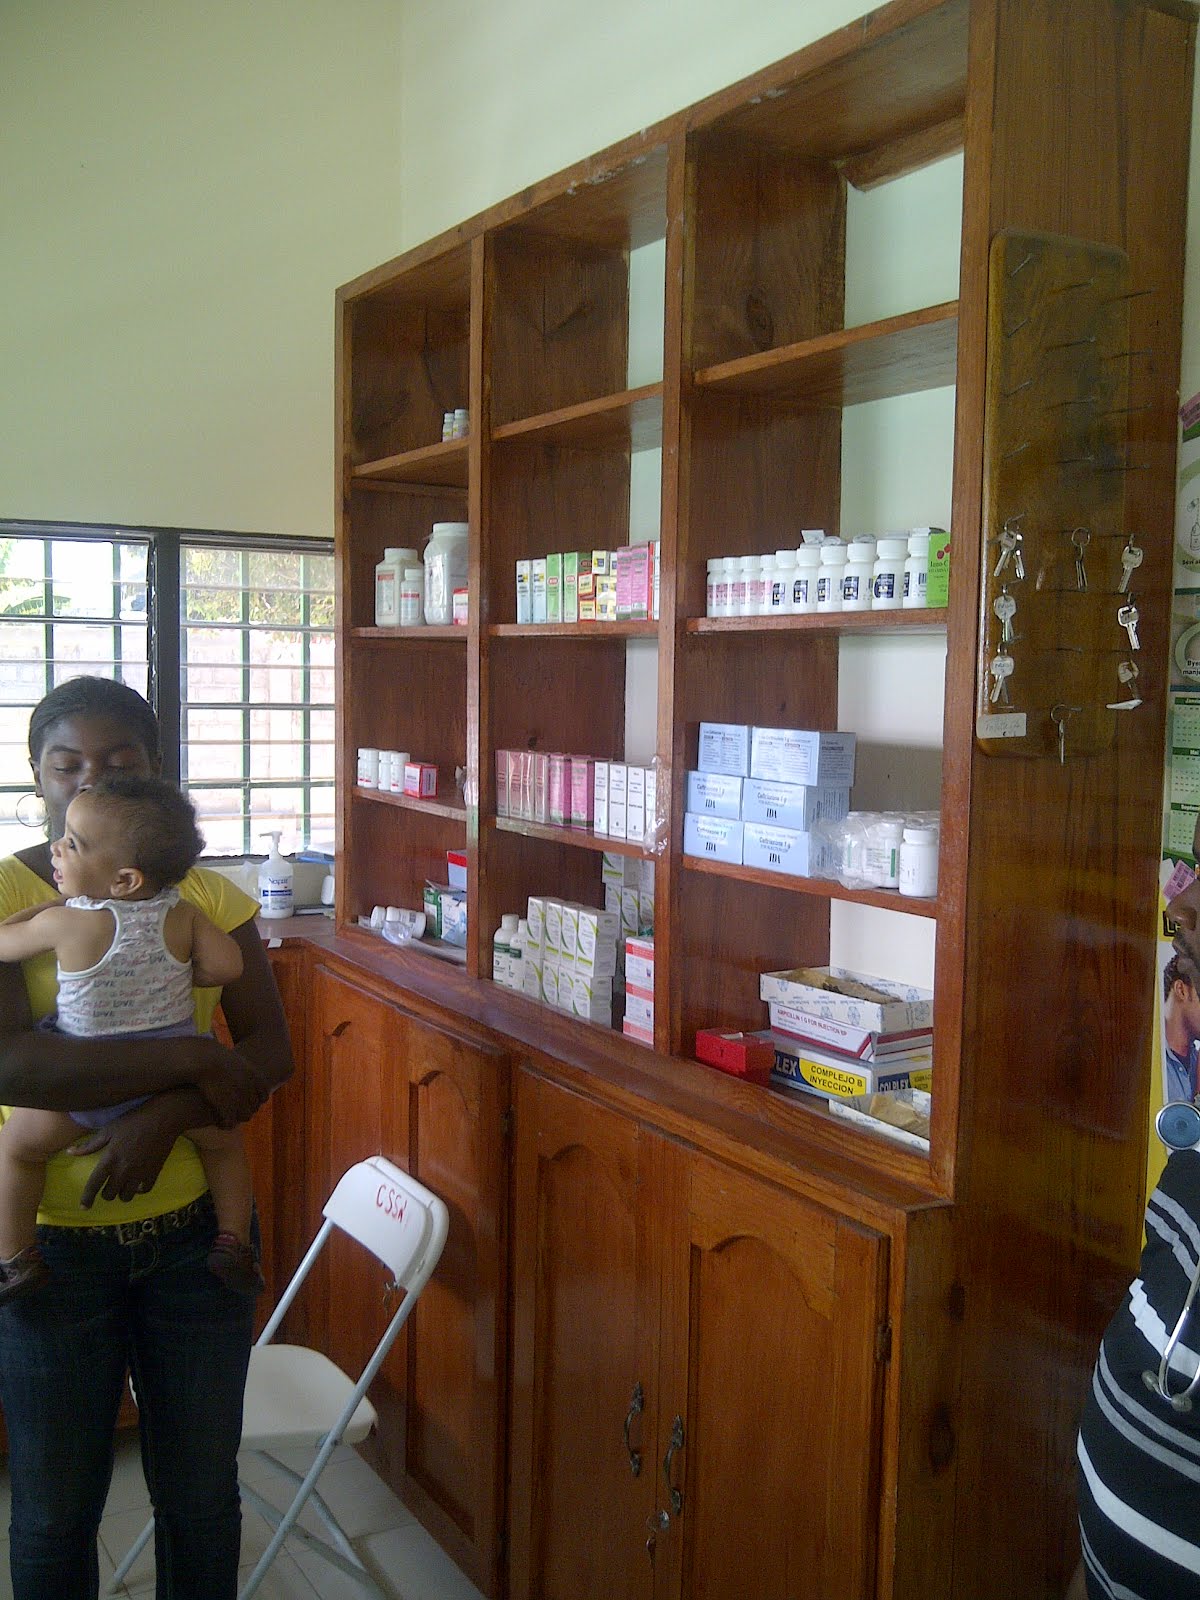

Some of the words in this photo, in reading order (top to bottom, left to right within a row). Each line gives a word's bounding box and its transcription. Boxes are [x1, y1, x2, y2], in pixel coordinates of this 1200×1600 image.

[809, 1075, 854, 1095] INYECCION
[810, 1065, 855, 1085] COMPLEJO
[857, 1079, 863, 1088] B
